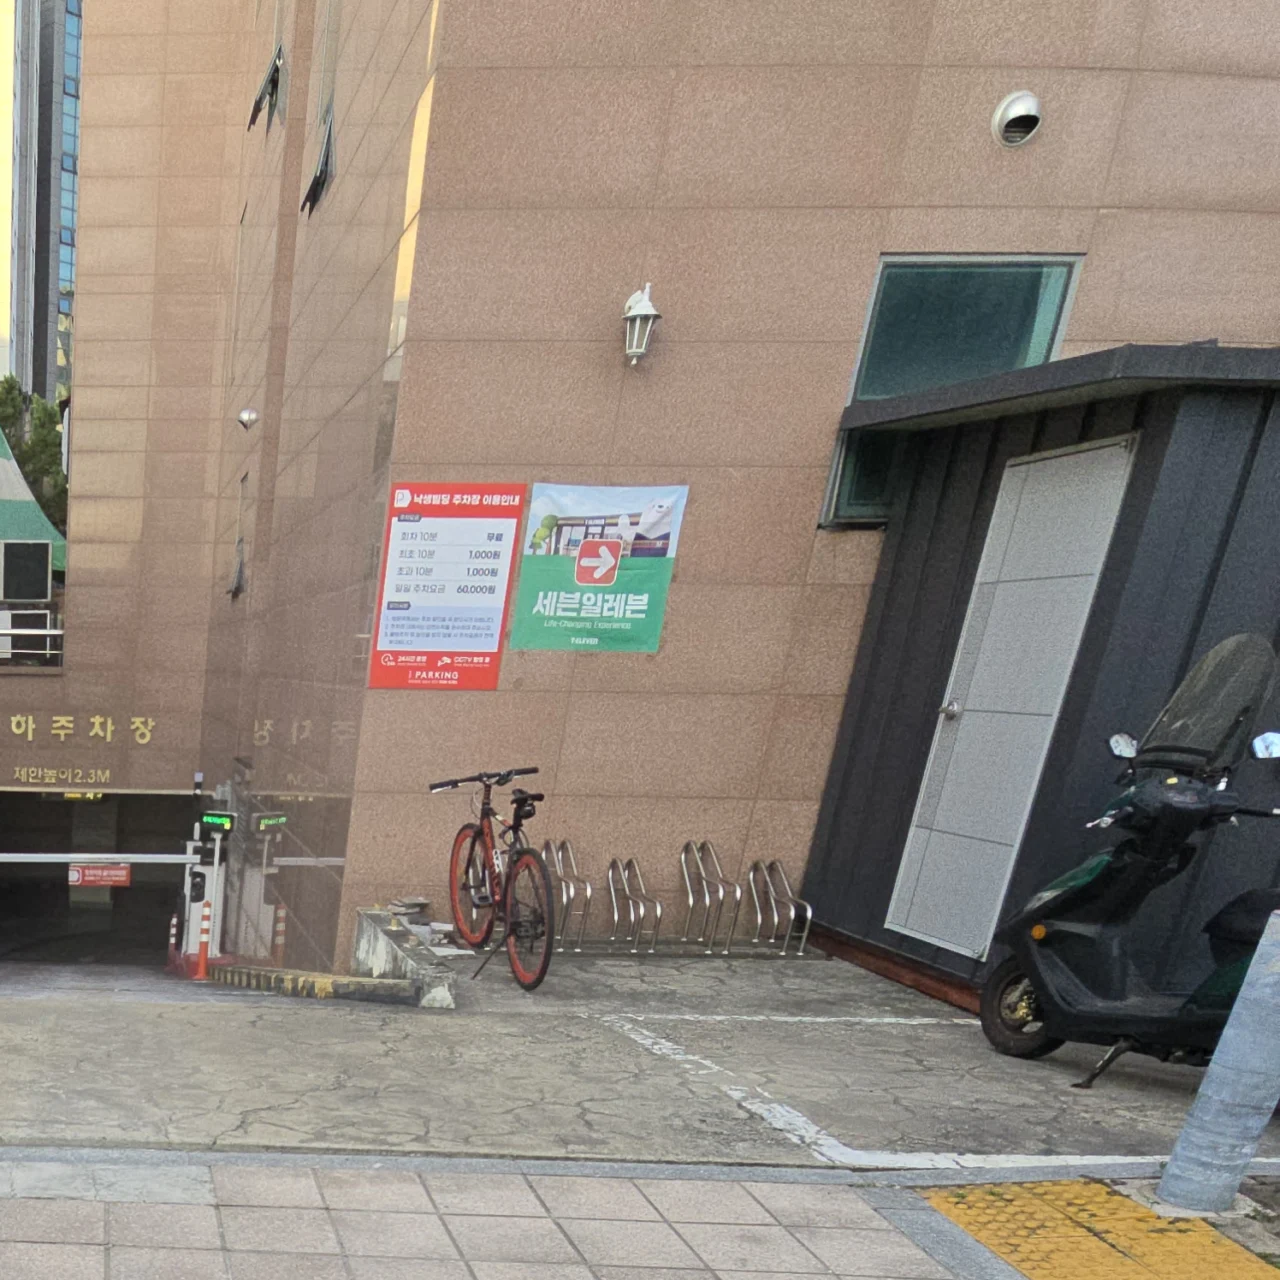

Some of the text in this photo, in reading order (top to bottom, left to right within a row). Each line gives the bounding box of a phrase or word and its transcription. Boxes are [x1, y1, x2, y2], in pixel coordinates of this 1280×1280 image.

[452, 494, 481, 506] 주차장
[532, 591, 649, 619] 세븐일레븐
[415, 671, 459, 679] PARKING
